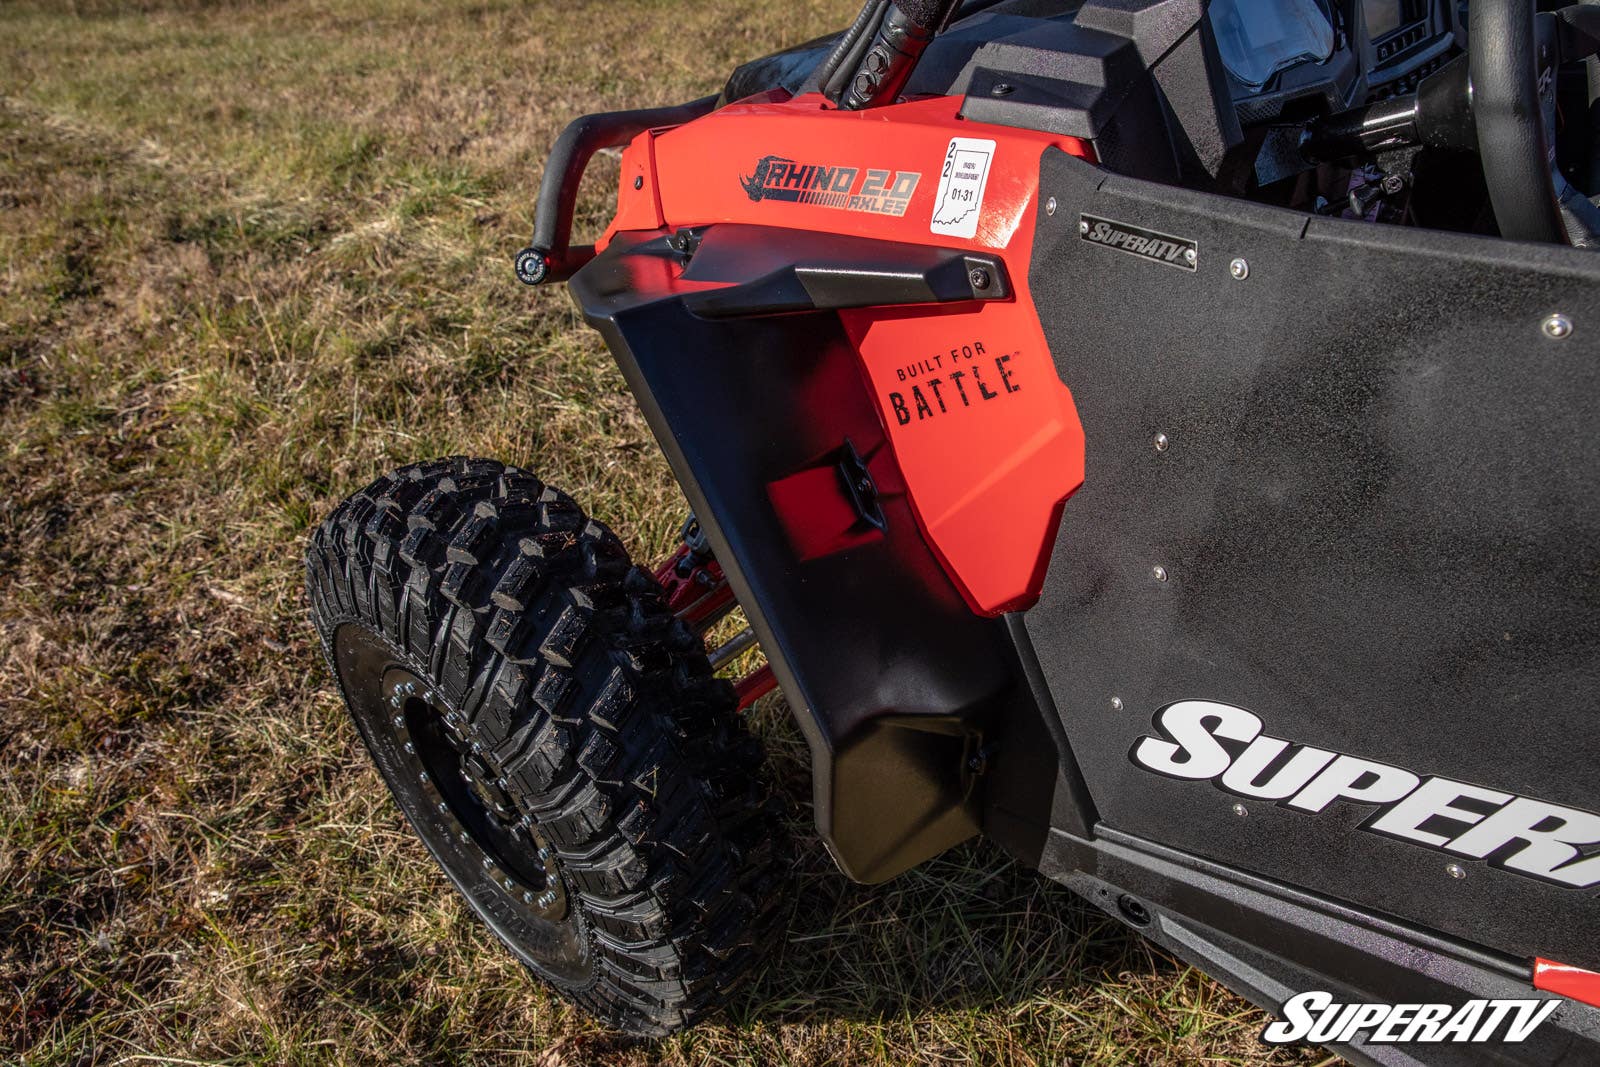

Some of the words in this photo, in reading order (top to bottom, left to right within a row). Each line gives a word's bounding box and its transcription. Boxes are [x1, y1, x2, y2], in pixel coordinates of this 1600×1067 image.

[766, 162, 859, 193] RHINO
[861, 168, 922, 198] 2.0
[951, 187, 974, 202] 01-31
[848, 195, 907, 216] AXLES
[1088, 222, 1186, 261] SUPERATV
[896, 354, 943, 382] BUILT
[950, 341, 986, 364] FOR
[888, 354, 1021, 426] BATTLE
[1132, 699, 1600, 888] SUPER
